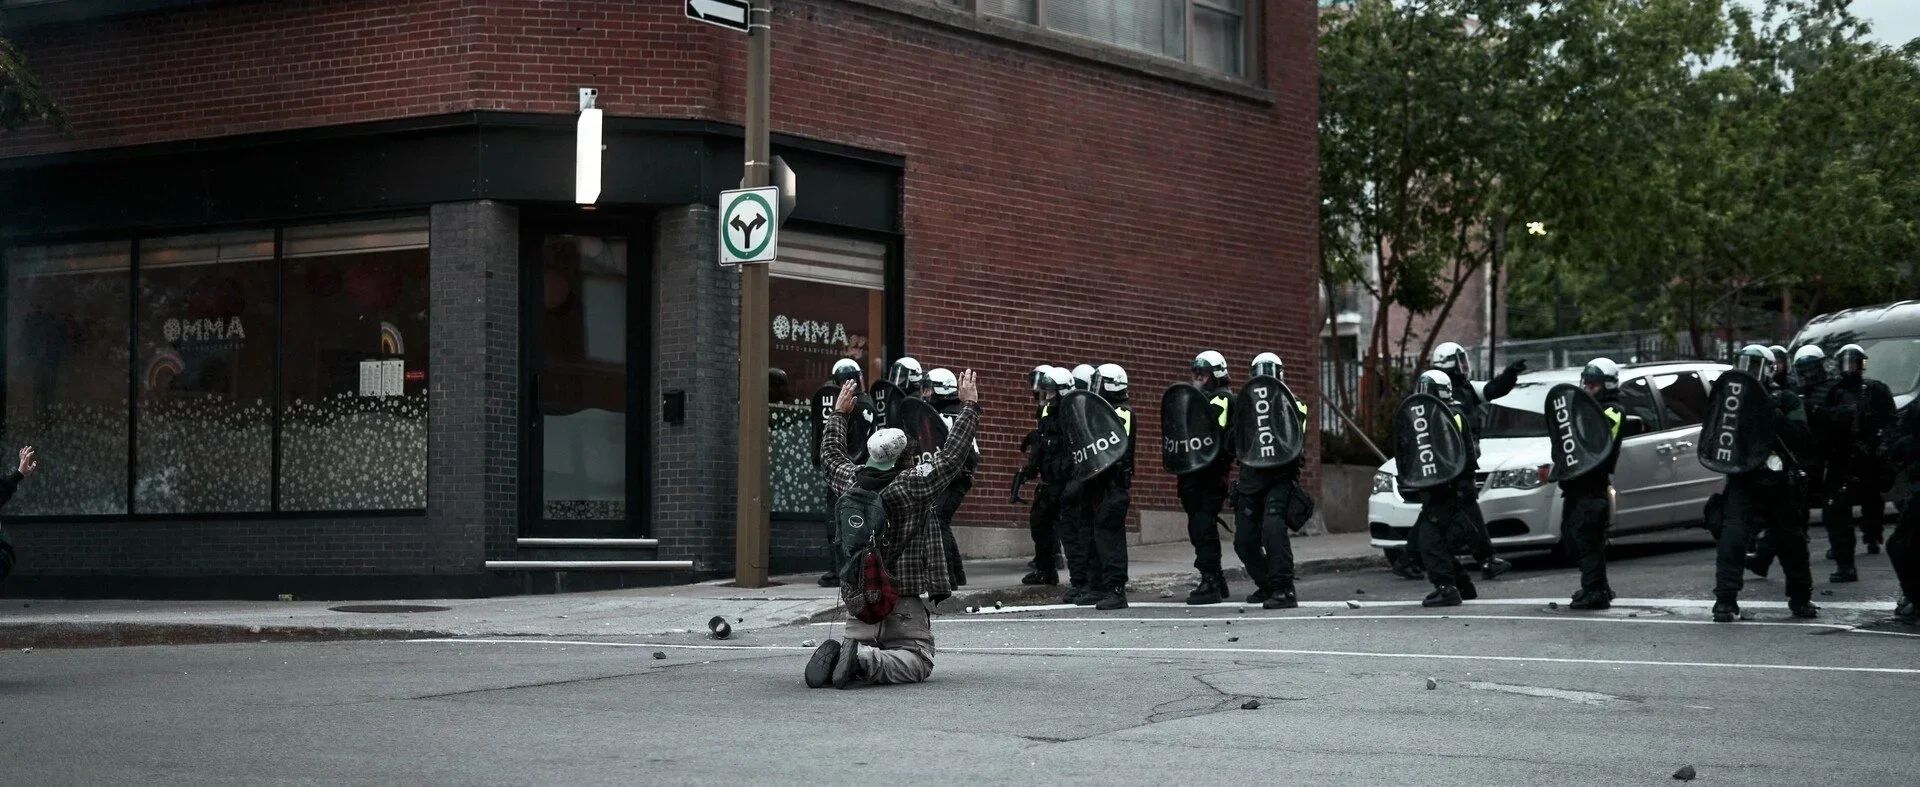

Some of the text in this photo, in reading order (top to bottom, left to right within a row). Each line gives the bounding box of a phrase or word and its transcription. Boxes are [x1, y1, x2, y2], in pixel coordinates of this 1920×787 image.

[163, 316, 246, 341] OMMA
[773, 314, 849, 345] OMMA
[875, 389, 887, 431] LICE
[1254, 386, 1276, 458] POLICE
[1553, 395, 1579, 467] POLICE
[1717, 382, 1742, 461] POLICE
[1072, 431, 1121, 464] POLICE
[1410, 404, 1437, 477] POLICE
